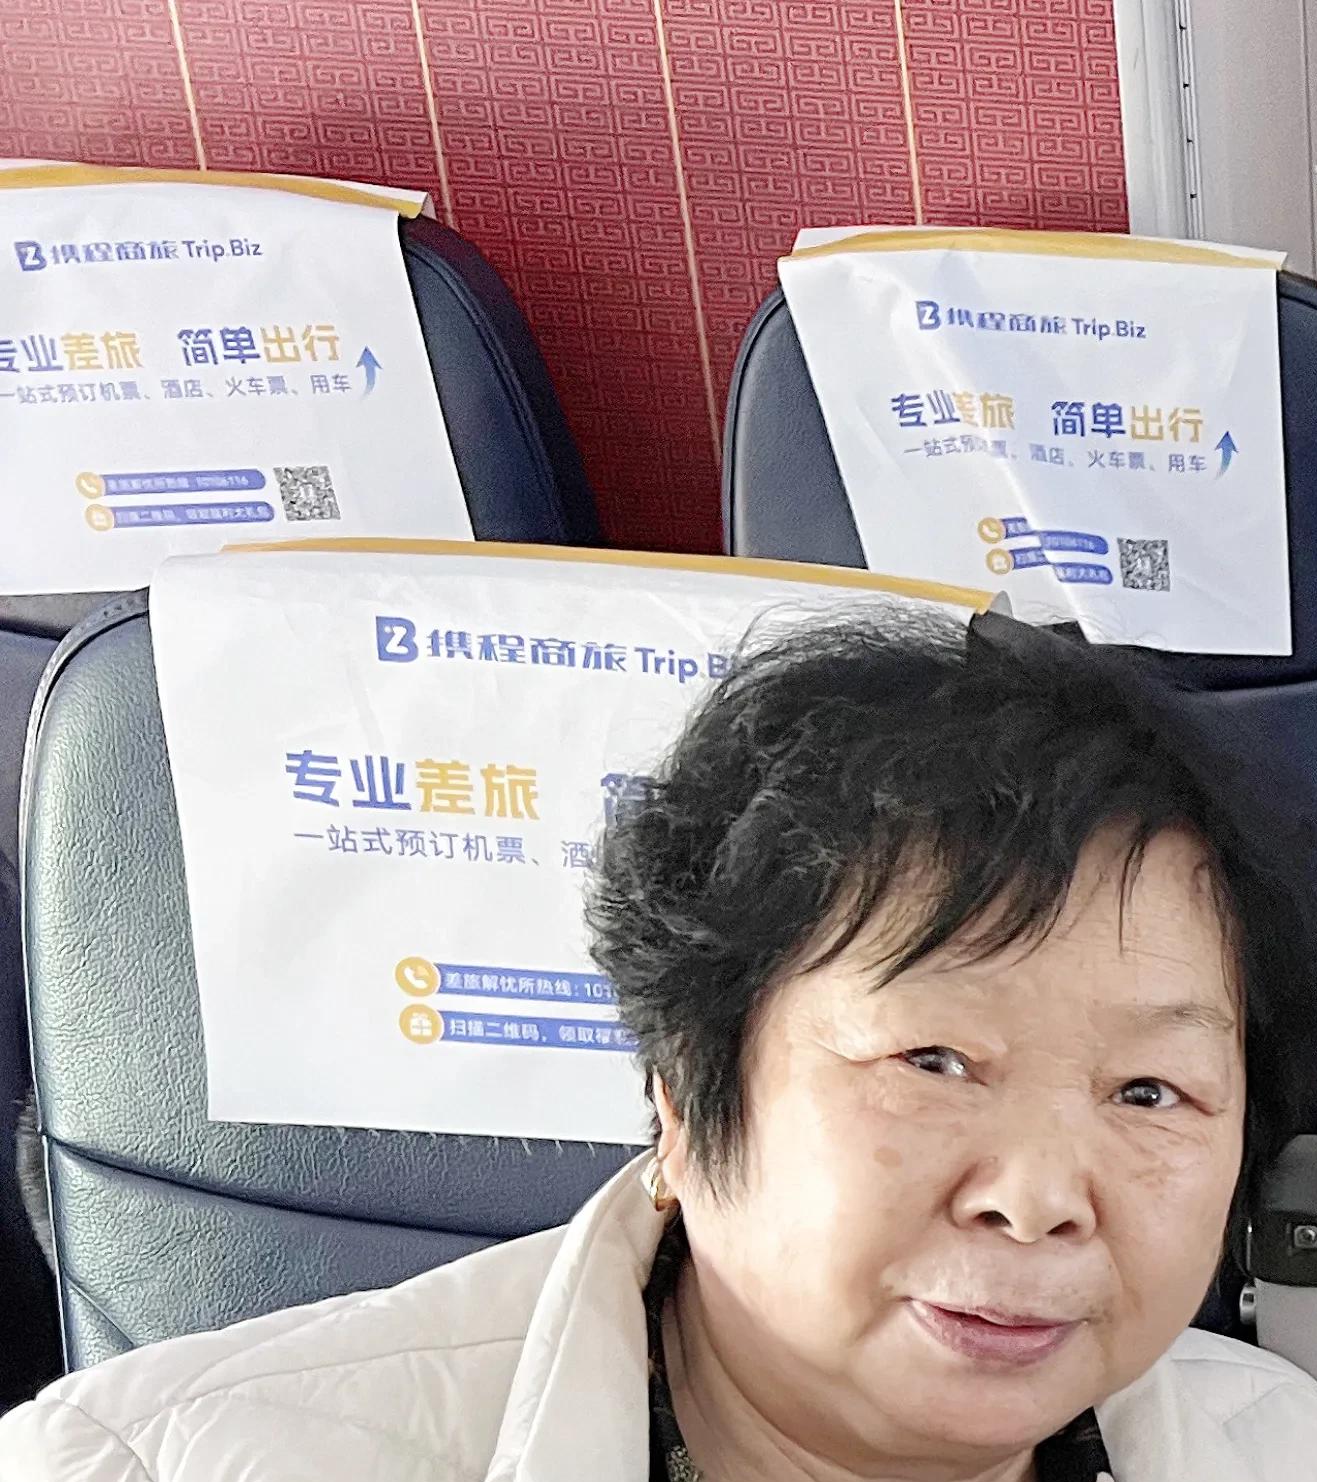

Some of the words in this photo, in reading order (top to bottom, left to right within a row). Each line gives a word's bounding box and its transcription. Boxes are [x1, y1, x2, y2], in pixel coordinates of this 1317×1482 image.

[183, 239, 263, 262] Trip.Biz
[177, 324, 340, 367] 简单出行
[1071, 317, 1147, 340] Trip.Biz
[891, 390, 1017, 430] 专业差旅
[1051, 401, 1204, 443] 简单出行
[427, 629, 628, 673] 携程商旅
[635, 646, 733, 683] Trip.B
[286, 749, 541, 821] 专业差旅
[294, 824, 594, 869] 一站式预订机票、酒
